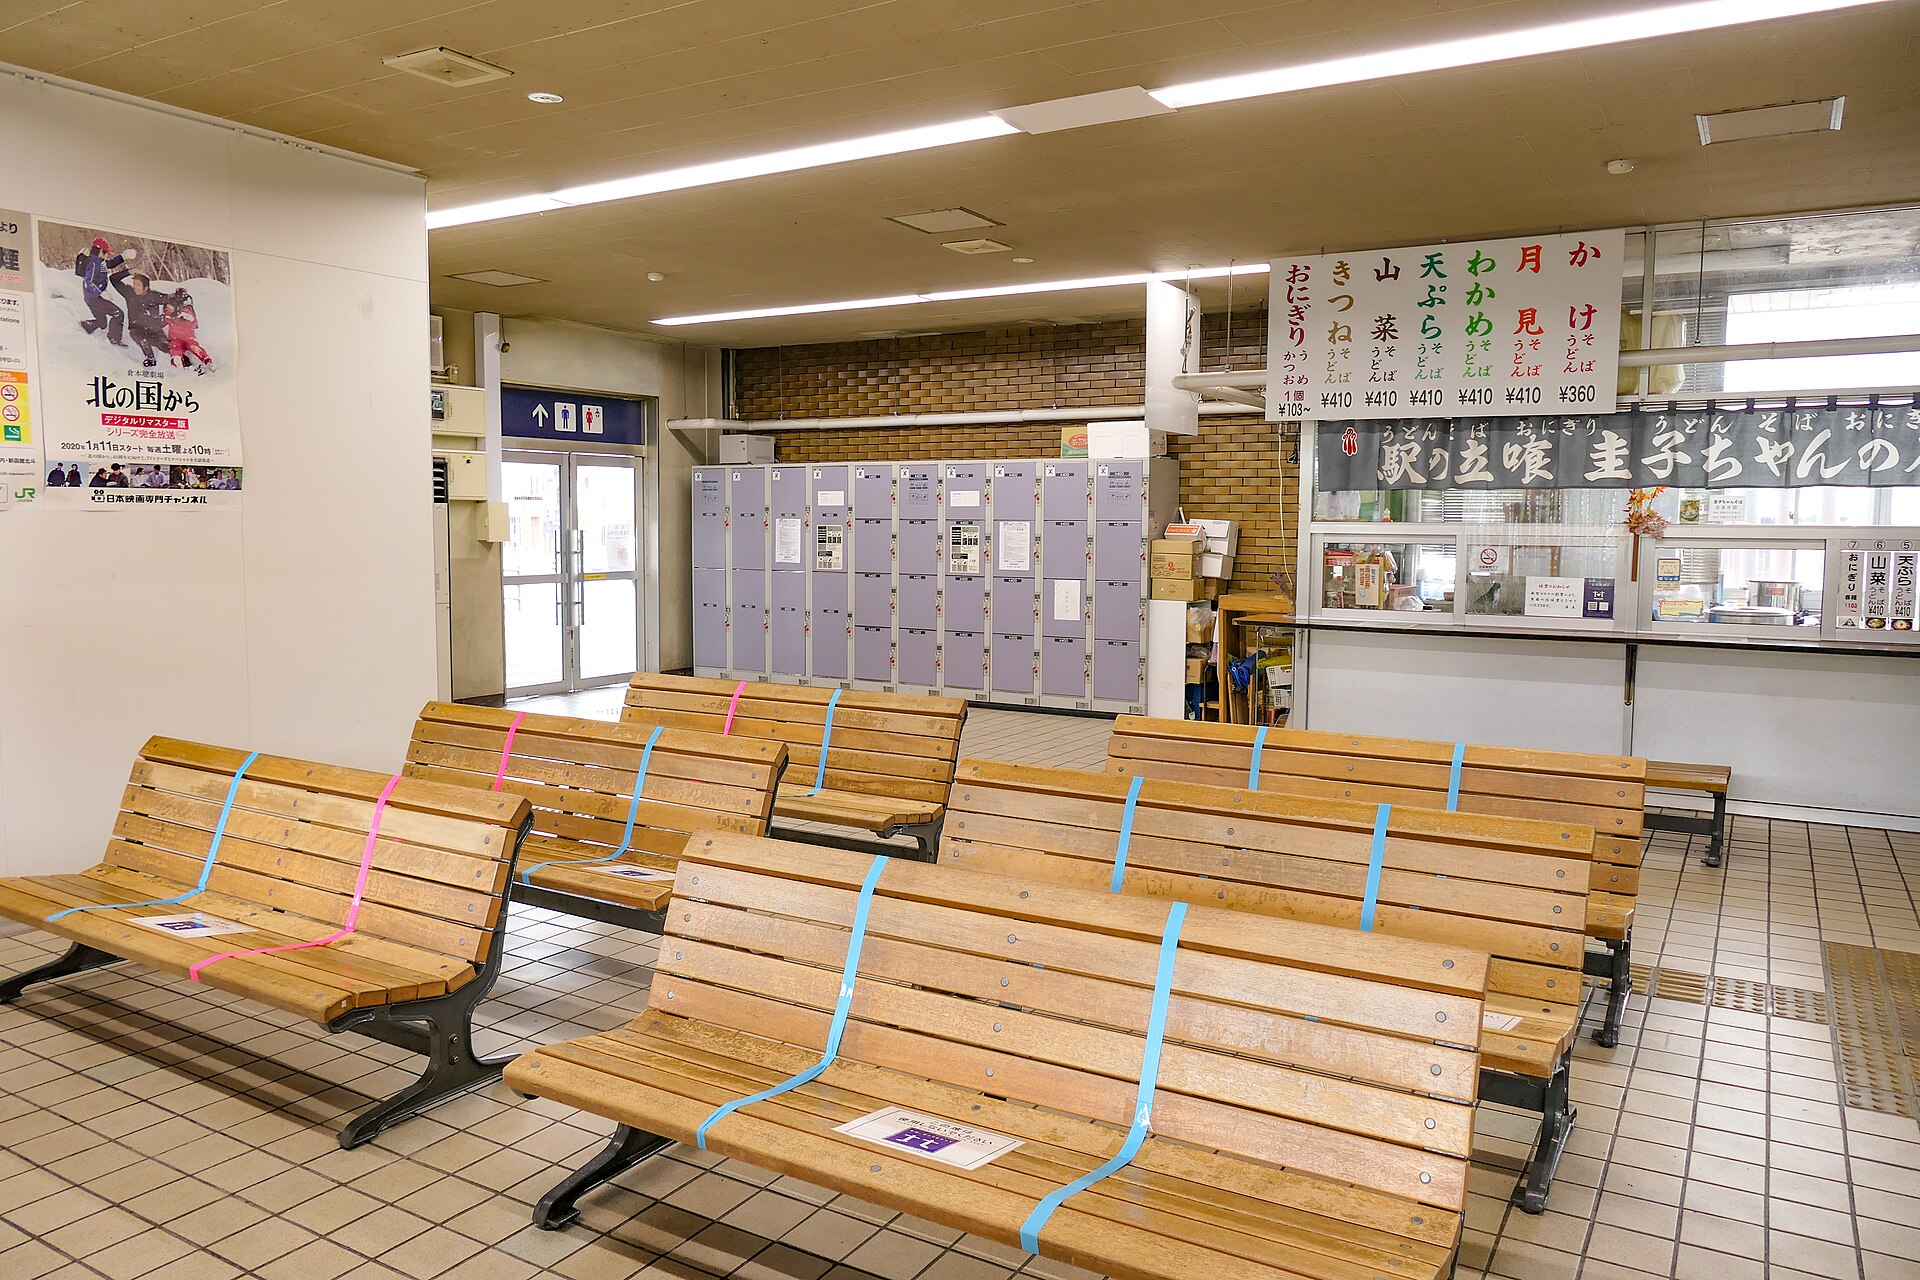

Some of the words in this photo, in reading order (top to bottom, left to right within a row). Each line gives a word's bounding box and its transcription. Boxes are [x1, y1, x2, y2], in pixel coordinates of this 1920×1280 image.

[1327, 260, 1355, 346] きつね
[1371, 257, 1401, 343] 山菜
[1417, 252, 1448, 340] 天ぷら
[1465, 249, 1497, 337] わかめ
[1512, 244, 1544, 335] 月見
[1568, 241, 1602, 331] かけ
[1286, 264, 1311, 348] おにぎり
[1283, 350, 1296, 386] かつお
[1324, 348, 1338, 384] うどん
[1339, 348, 1352, 384] そば
[1368, 346, 1383, 382] うどん
[1383, 345, 1397, 382] そば
[1414, 343, 1428, 380] うどん
[1429, 342, 1444, 380] そば
[1462, 340, 1477, 378] うどん
[1478, 339, 1493, 377] そば
[1510, 339, 1526, 378] うどん
[1527, 338, 1543, 377] そば
[1563, 335, 1580, 374] うどん
[1580, 334, 1597, 373] そば
[86, 375, 200, 414] 北の国から
[1284, 390, 1305, 402] 1個
[1320, 391, 1352, 408] ¥410
[1365, 390, 1397, 407] ¥410
[1409, 389, 1443, 406] ¥410
[1458, 387, 1493, 406] ¥410
[1505, 386, 1541, 404] ¥410
[1559, 384, 1596, 403] ¥360
[104, 415, 187, 429] デジタルリマスター版
[107, 427, 176, 440] シリーズ完全放送
[1381, 423, 1437, 443] うどん
[1516, 418, 1598, 437] おにぎり
[1655, 415, 1735, 436] うどん
[1759, 412, 1820, 432] そば
[1583, 428, 1920, 482] 圭子ちゃんの
[15, 488, 35, 498] JR
[106, 493, 208, 504] 日本映画専門チャンネル
[1847, 553, 1858, 591] おにぎり
[1870, 556, 1887, 585] 山菜
[1868, 605, 1884, 616] ¥410
[1895, 606, 1911, 617] ¥410
